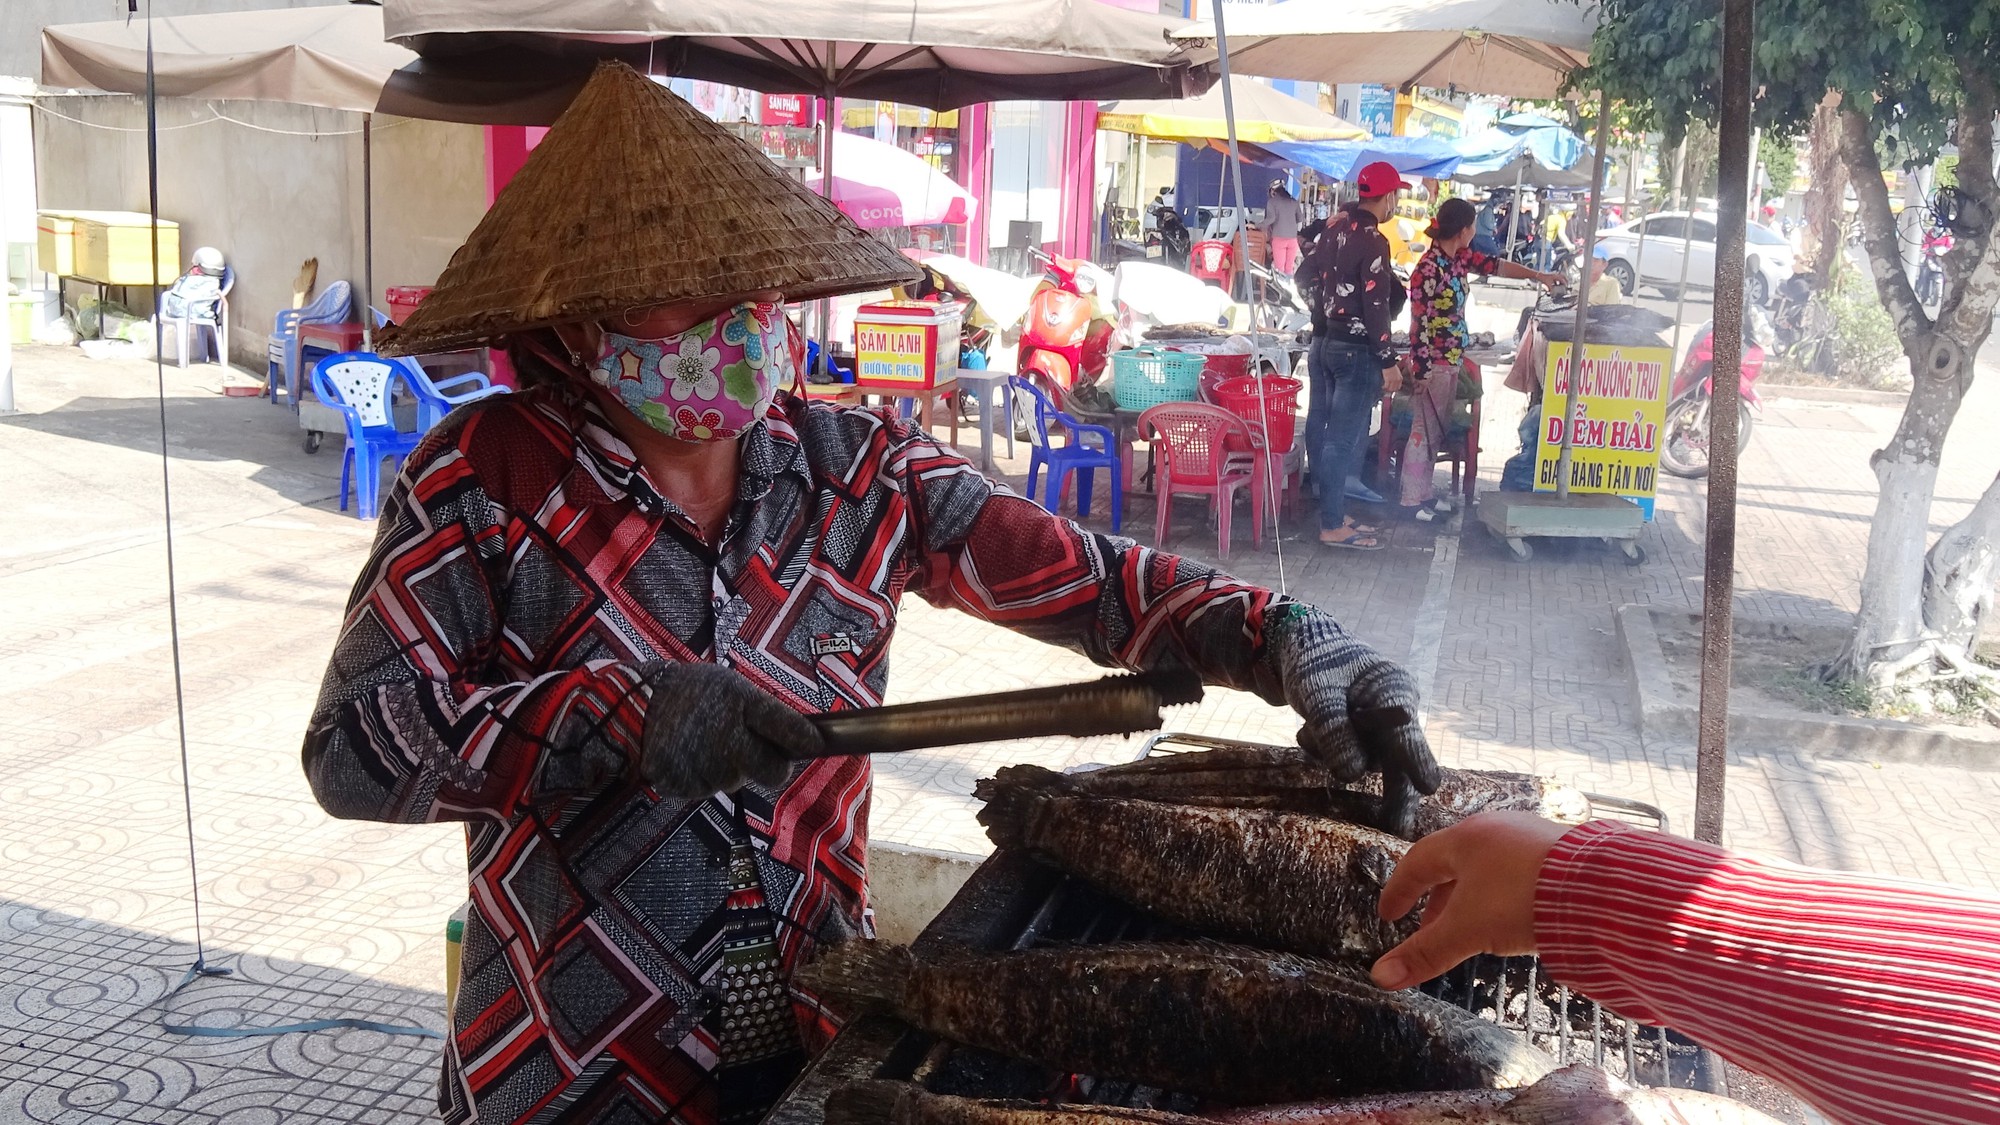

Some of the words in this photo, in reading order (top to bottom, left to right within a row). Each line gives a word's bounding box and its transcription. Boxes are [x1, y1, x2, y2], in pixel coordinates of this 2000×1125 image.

[860, 328, 887, 352] SÂM
[891, 333, 921, 357] LẠNH
[1555, 347, 1570, 395] CÁ
[1576, 348, 1594, 396] ÓC
[1594, 350, 1633, 398] NƯỚNG
[1634, 362, 1661, 401] TRUI
[1546, 404, 1605, 446] DỄM
[1609, 411, 1657, 450] HẢI
[1541, 458, 1566, 485] GIA
[1571, 457, 1603, 489] HÀNG
[1634, 465, 1656, 492] NƠI
[819, 639, 849, 649] FILA
